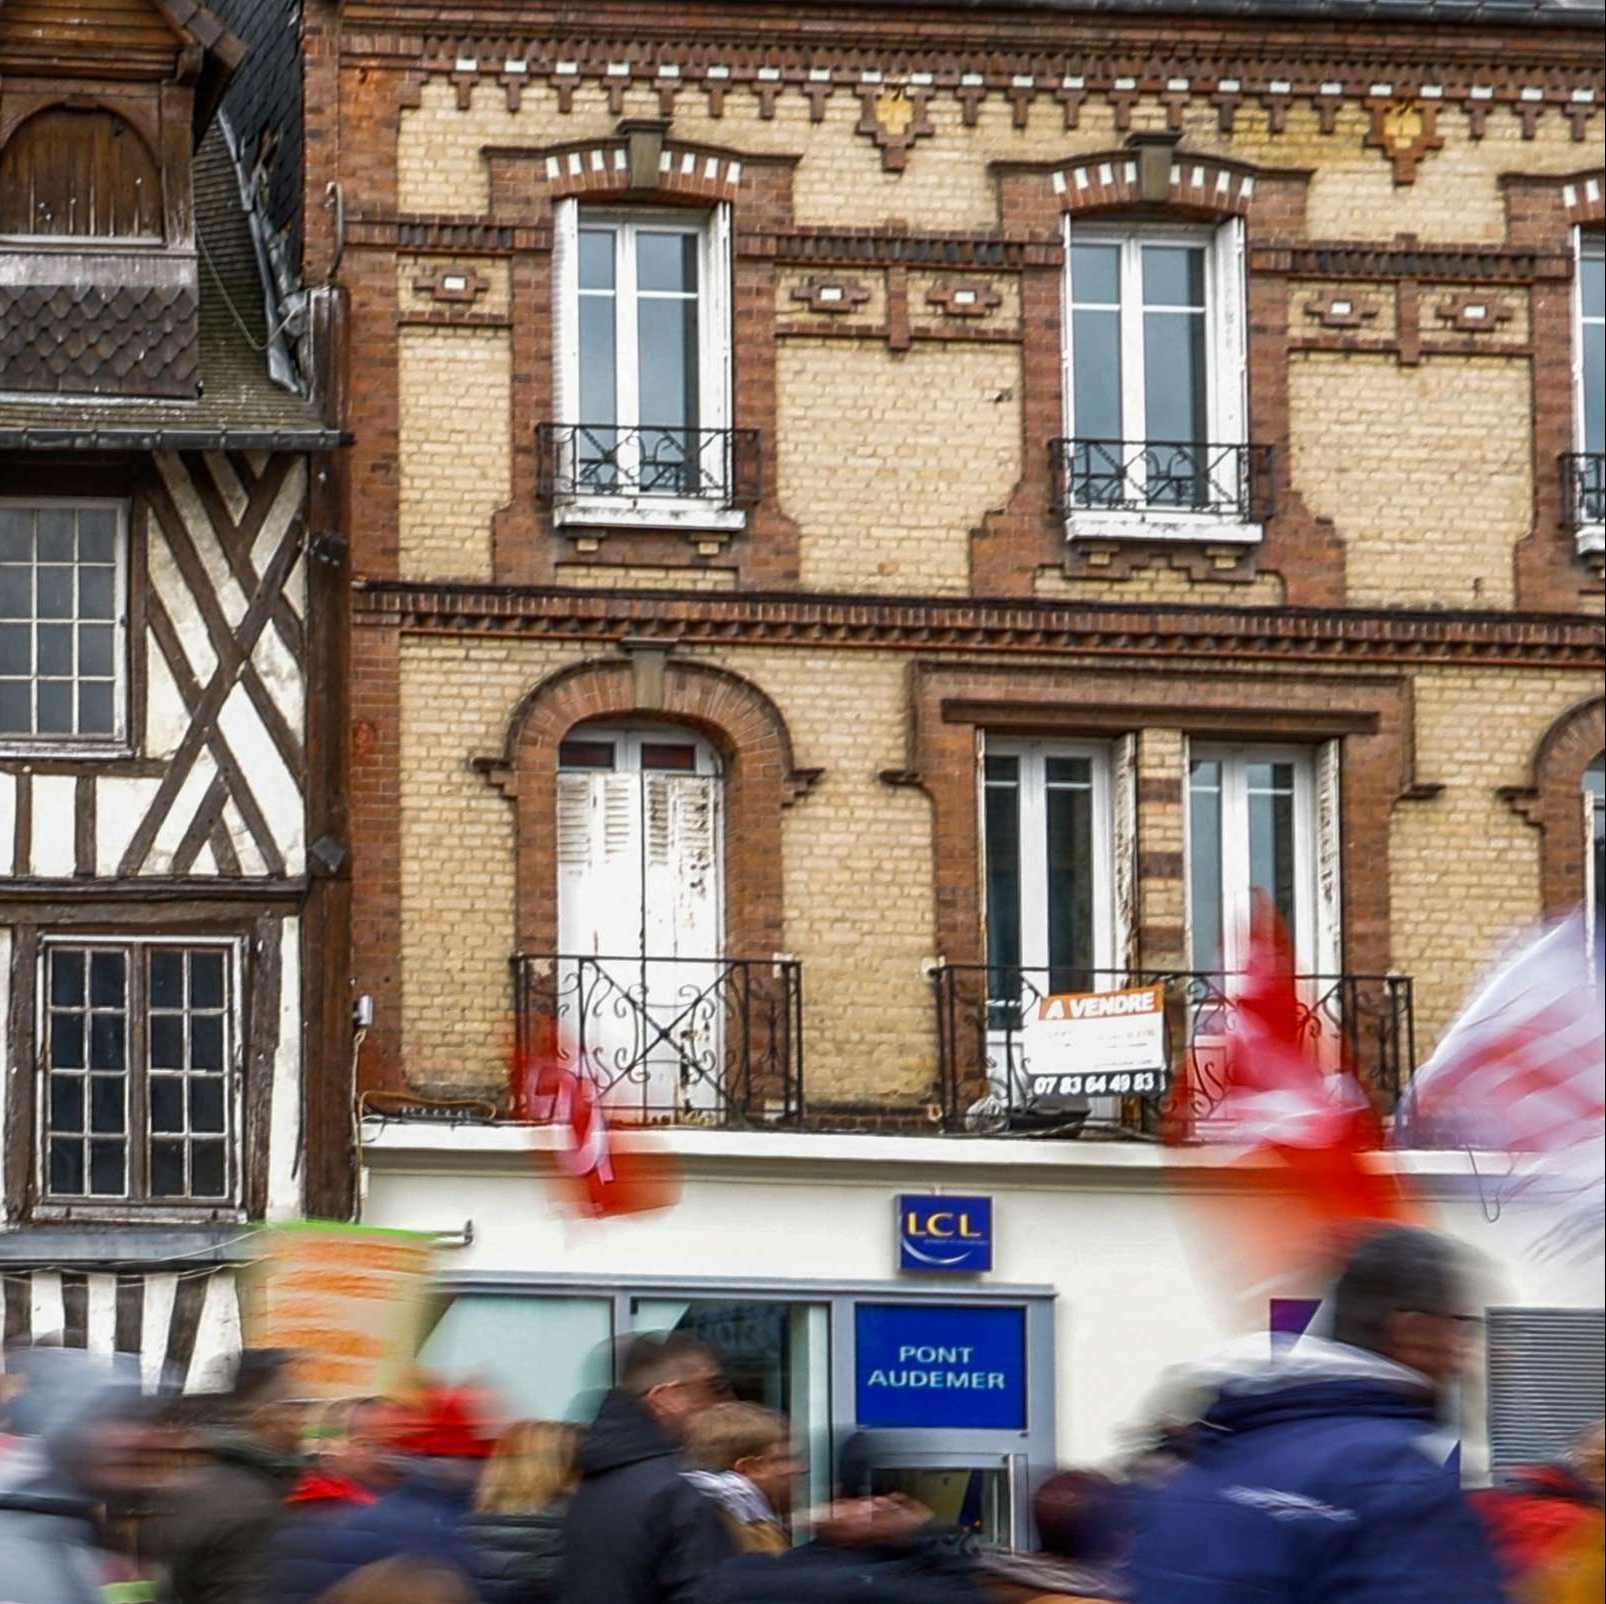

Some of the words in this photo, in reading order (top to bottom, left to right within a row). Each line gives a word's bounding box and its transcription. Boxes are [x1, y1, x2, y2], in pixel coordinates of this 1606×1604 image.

[1044, 999, 1065, 1020] A
[1069, 992, 1155, 1018] VENDRE
[1033, 1076, 1058, 1095] 07
[1059, 1076, 1082, 1095] 83
[1085, 1074, 1107, 1093] 64
[1109, 1074, 1130, 1092] 49
[1133, 1072, 1154, 1091] 83
[907, 1211, 982, 1238] LCL
[898, 1345, 974, 1364] PONT
[866, 1369, 1006, 1390] AUDEMER
